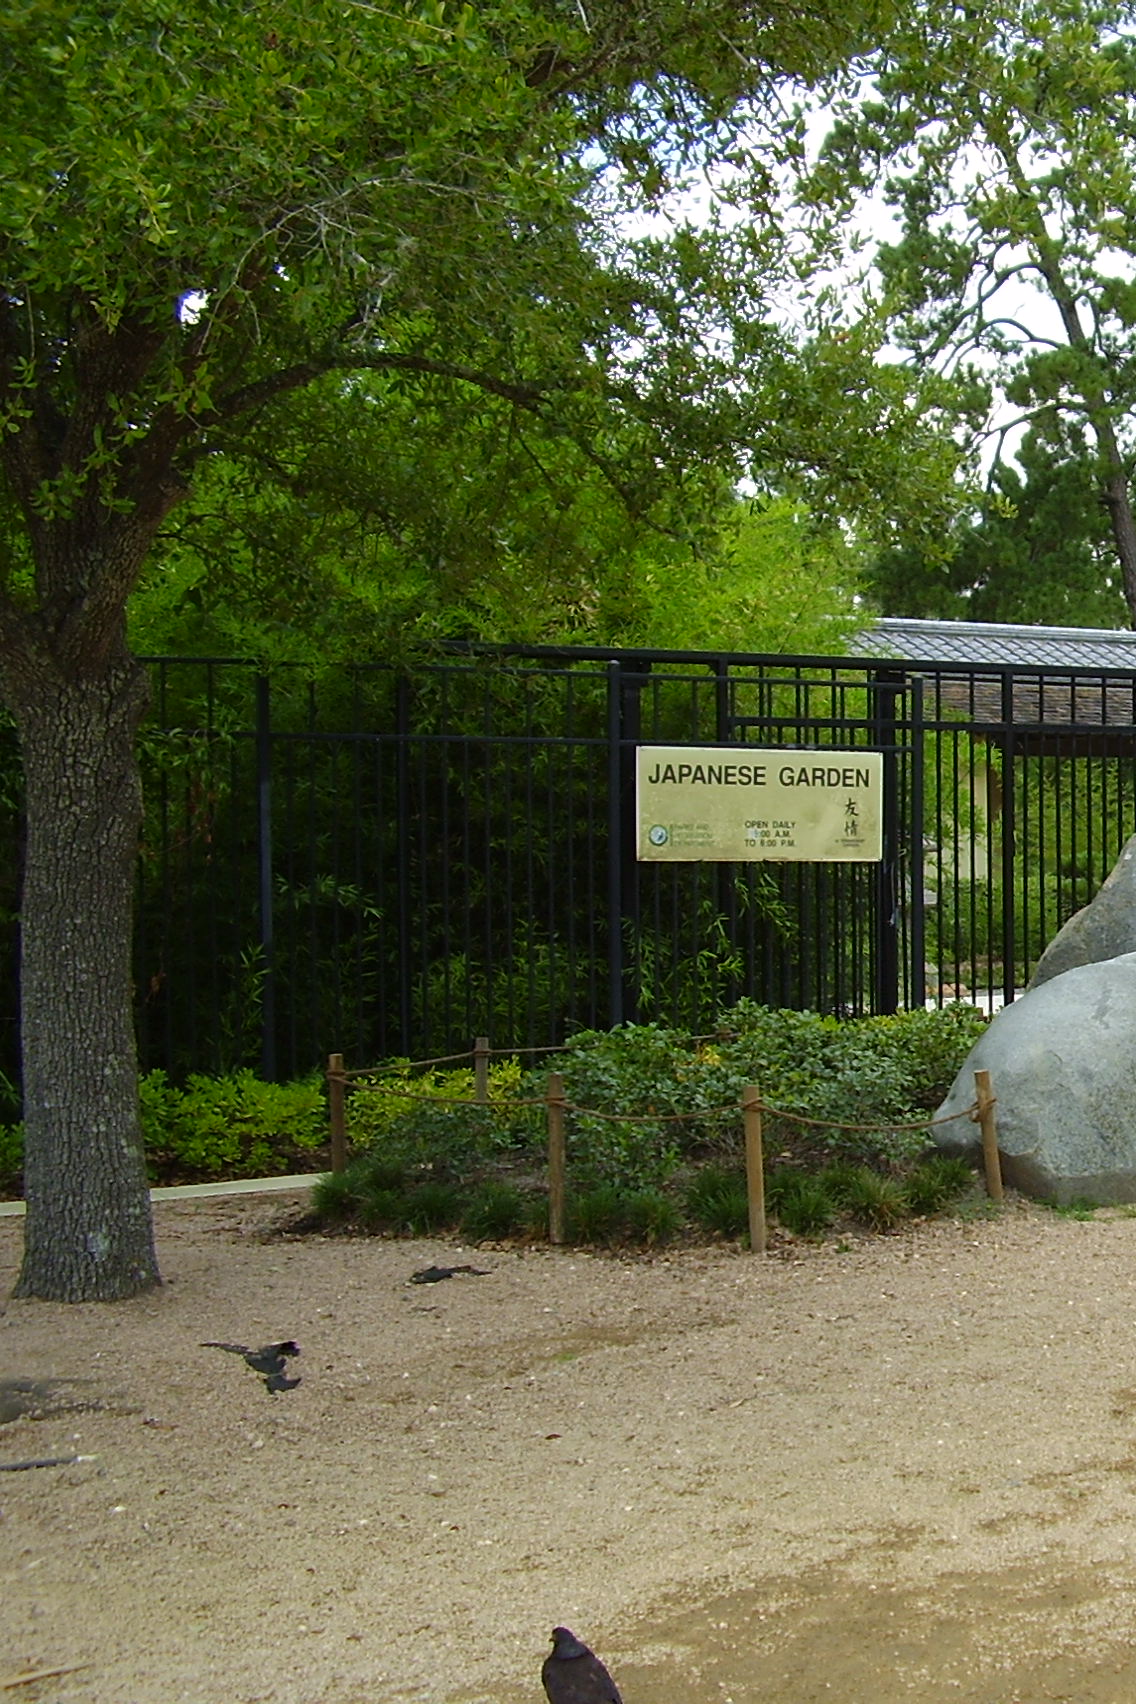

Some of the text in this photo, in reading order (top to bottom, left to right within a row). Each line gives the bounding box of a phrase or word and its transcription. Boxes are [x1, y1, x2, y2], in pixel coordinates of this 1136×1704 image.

[648, 764, 870, 787] JAPANESE GARDEN
[744, 820, 796, 829] OPEN DAILY
[774, 829, 791, 838] A.M.
[744, 839, 756, 847] TO
